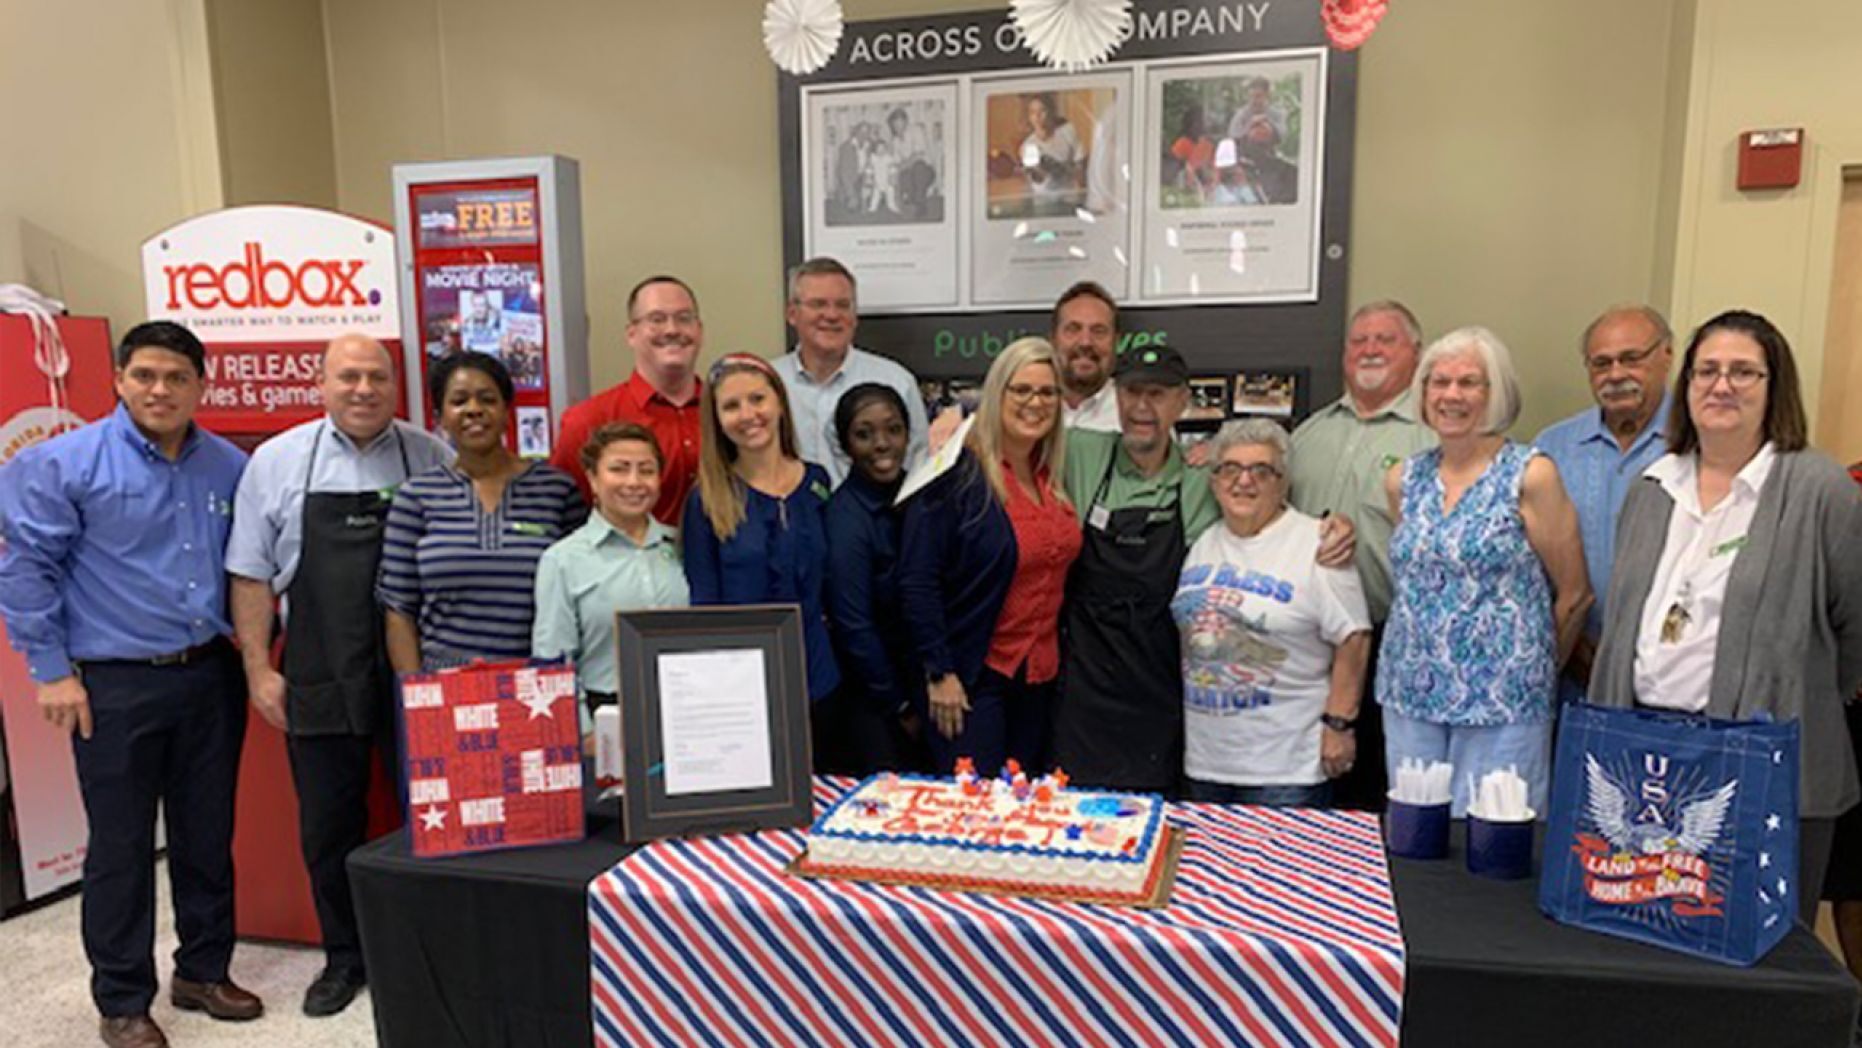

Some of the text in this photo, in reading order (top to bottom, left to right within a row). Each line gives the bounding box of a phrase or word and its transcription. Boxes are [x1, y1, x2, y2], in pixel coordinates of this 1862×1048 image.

[850, 26, 982, 63] ACROSS
[1124, 2, 1270, 41] MPANY
[456, 201, 533, 229] FREE
[425, 269, 536, 288] MOVIE NIGHT
[193, 317, 244, 326] SMARTER
[278, 315, 292, 325] TO
[352, 314, 382, 324] PLAY
[223, 353, 322, 380] RELEAS
[242, 382, 257, 405] &
[262, 386, 320, 412] game
[453, 702, 499, 732] WHITE
[459, 796, 506, 826] WHITE
[1587, 855, 1635, 876] LAND
